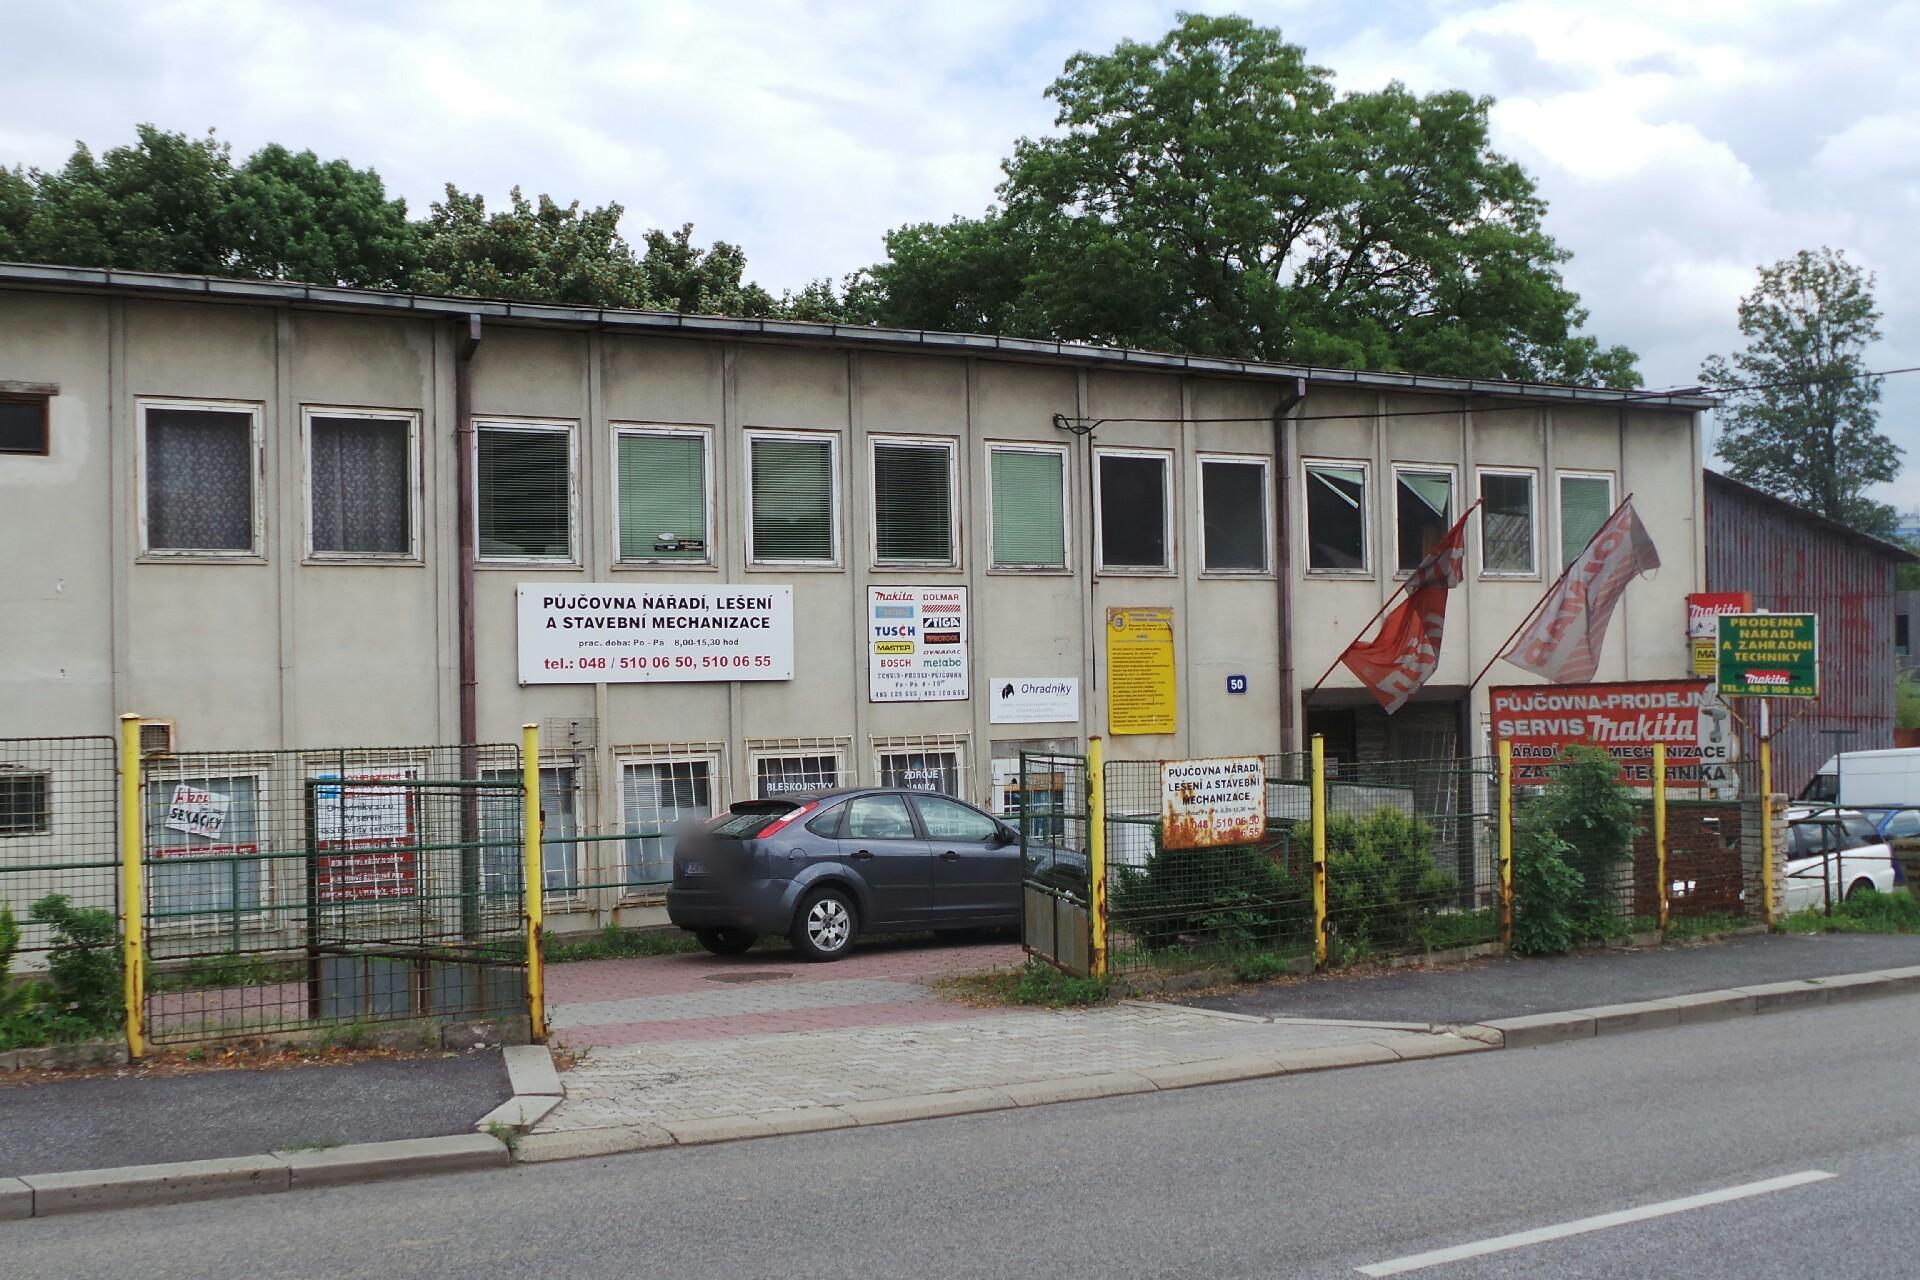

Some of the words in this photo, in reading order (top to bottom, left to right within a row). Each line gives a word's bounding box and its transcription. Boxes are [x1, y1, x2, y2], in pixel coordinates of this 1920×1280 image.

[543, 593, 636, 610] PŮJČOVNA
[643, 593, 709, 611] NÁŘADÍ,
[716, 594, 773, 610] LEŠENÍ
[923, 593, 959, 601] DOLMAR
[546, 617, 557, 629] A
[563, 614, 646, 629] STAVEBNÍ
[652, 616, 770, 629] MECHANIZACE
[1730, 617, 1804, 628] PRODEJNA
[875, 625, 916, 637] TUSCH
[578, 640, 602, 648] prac.
[633, 638, 645, 646] Po
[723, 638, 739, 646] hod
[1722, 641, 1732, 650] A
[544, 657, 574, 669] tel.:
[578, 657, 606, 669] 048
[620, 657, 647, 669] 510
[652, 656, 670, 668] 06
[675, 656, 697, 669] 50,
[702, 656, 728, 668] 510
[733, 656, 750, 667] 06
[754, 656, 771, 667] 55
[923, 657, 962, 667] metabo
[1734, 652, 1800, 662] TECHNIKY
[881, 659, 912, 667] BOSCH
[1231, 679, 1243, 690] 50
[1499, 718, 1585, 737] SERVIS
[904, 770, 939, 780] ZDROJE
[1168, 764, 1222, 778] PŮJČOVNA
[1168, 780, 1203, 792] LEŠENÍ
[1206, 781, 1213, 789] A
[1214, 778, 1260, 789] STAVEBNÍ
[1182, 792, 1251, 805] MECHANIZACE
[1216, 818, 1233, 828] 510
[1249, 827, 1260, 837] 55
